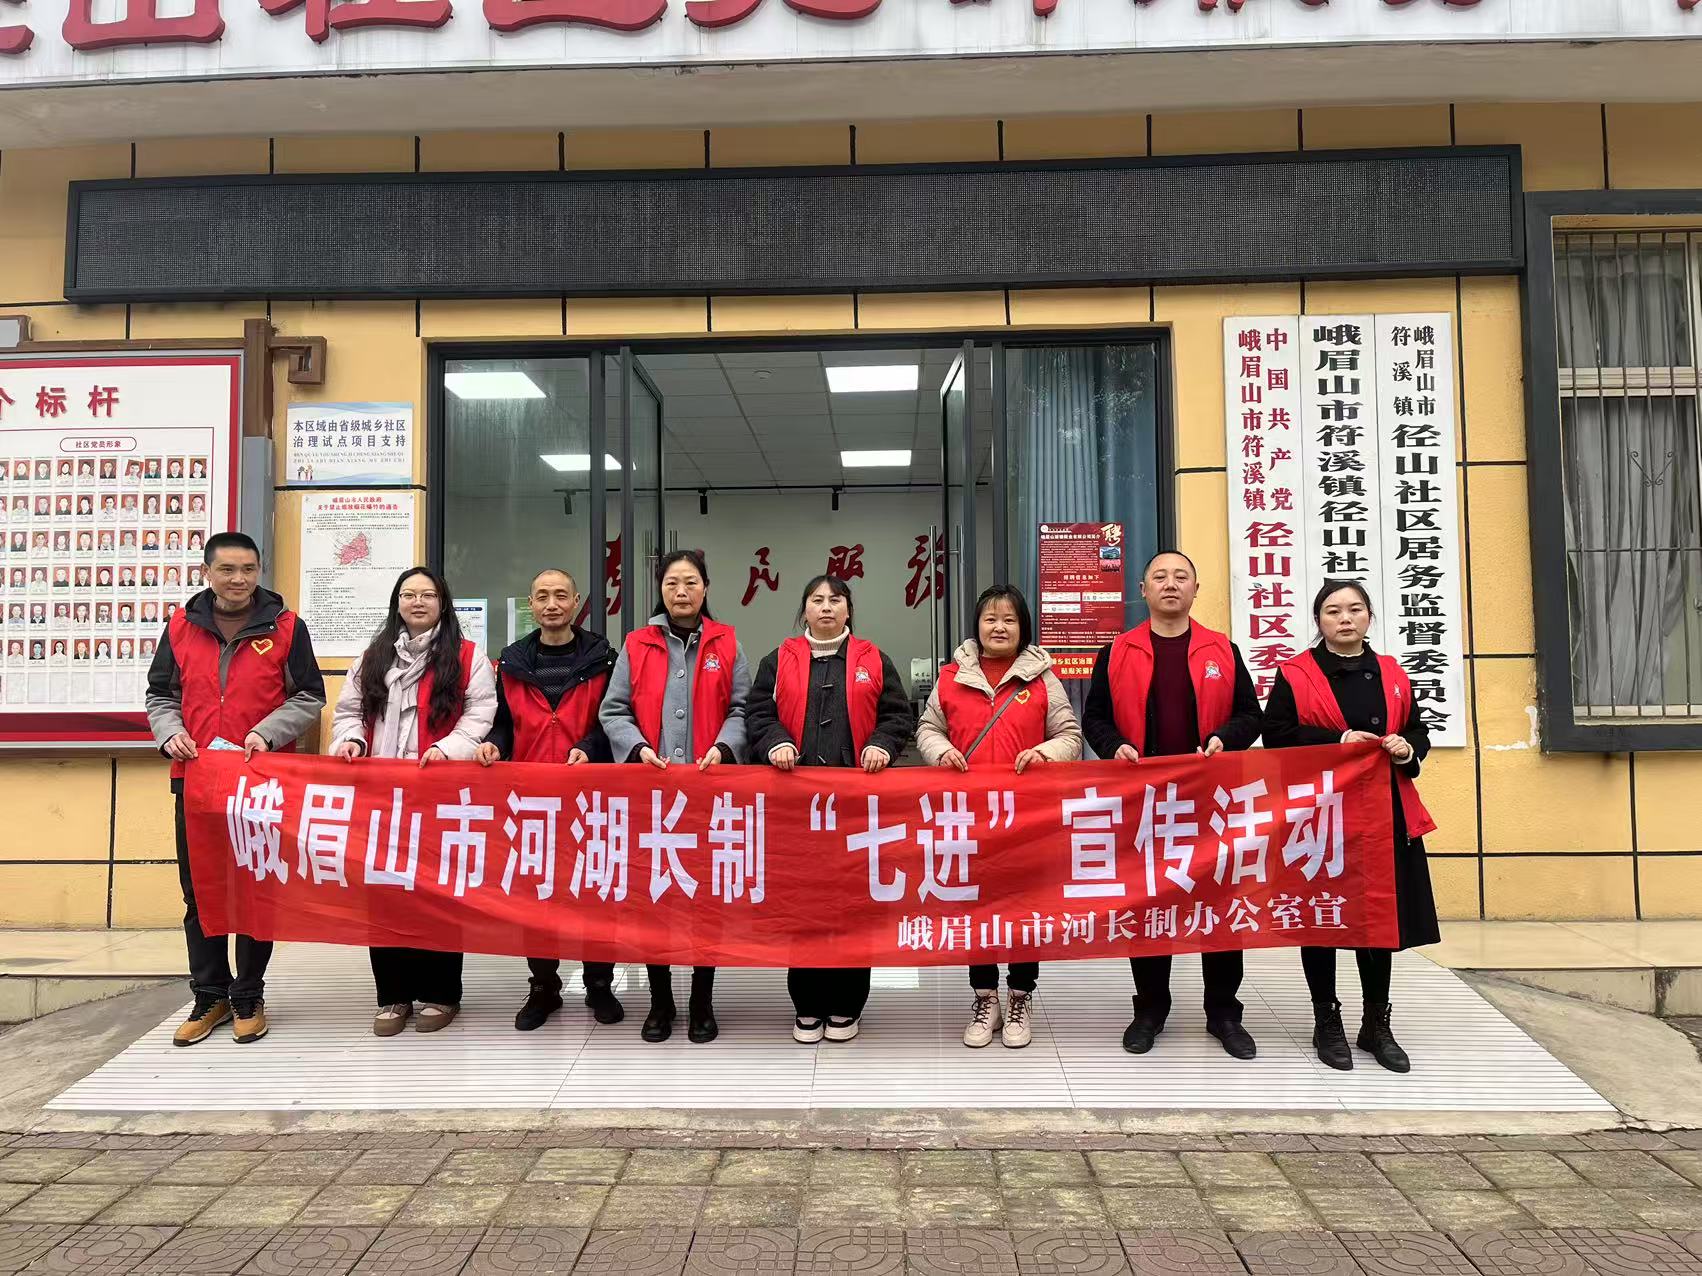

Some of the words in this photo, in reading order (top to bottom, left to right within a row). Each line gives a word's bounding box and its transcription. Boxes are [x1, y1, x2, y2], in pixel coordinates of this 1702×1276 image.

[1391, 326, 1414, 418] 符溪镇
[1414, 326, 1436, 417] 峨眉山市
[293, 419, 406, 432] 本区域由省级城乡社区
[293, 435, 406, 447] 治理试点项目支持
[1238, 328, 1266, 513] 峨眉山市符溪镇
[1265, 328, 1294, 512] 中国共产党
[1312, 324, 1370, 587] 峨眉山市符溪镇径山社
[897, 892, 1349, 951] 峨眉山市河长制办公室宣
